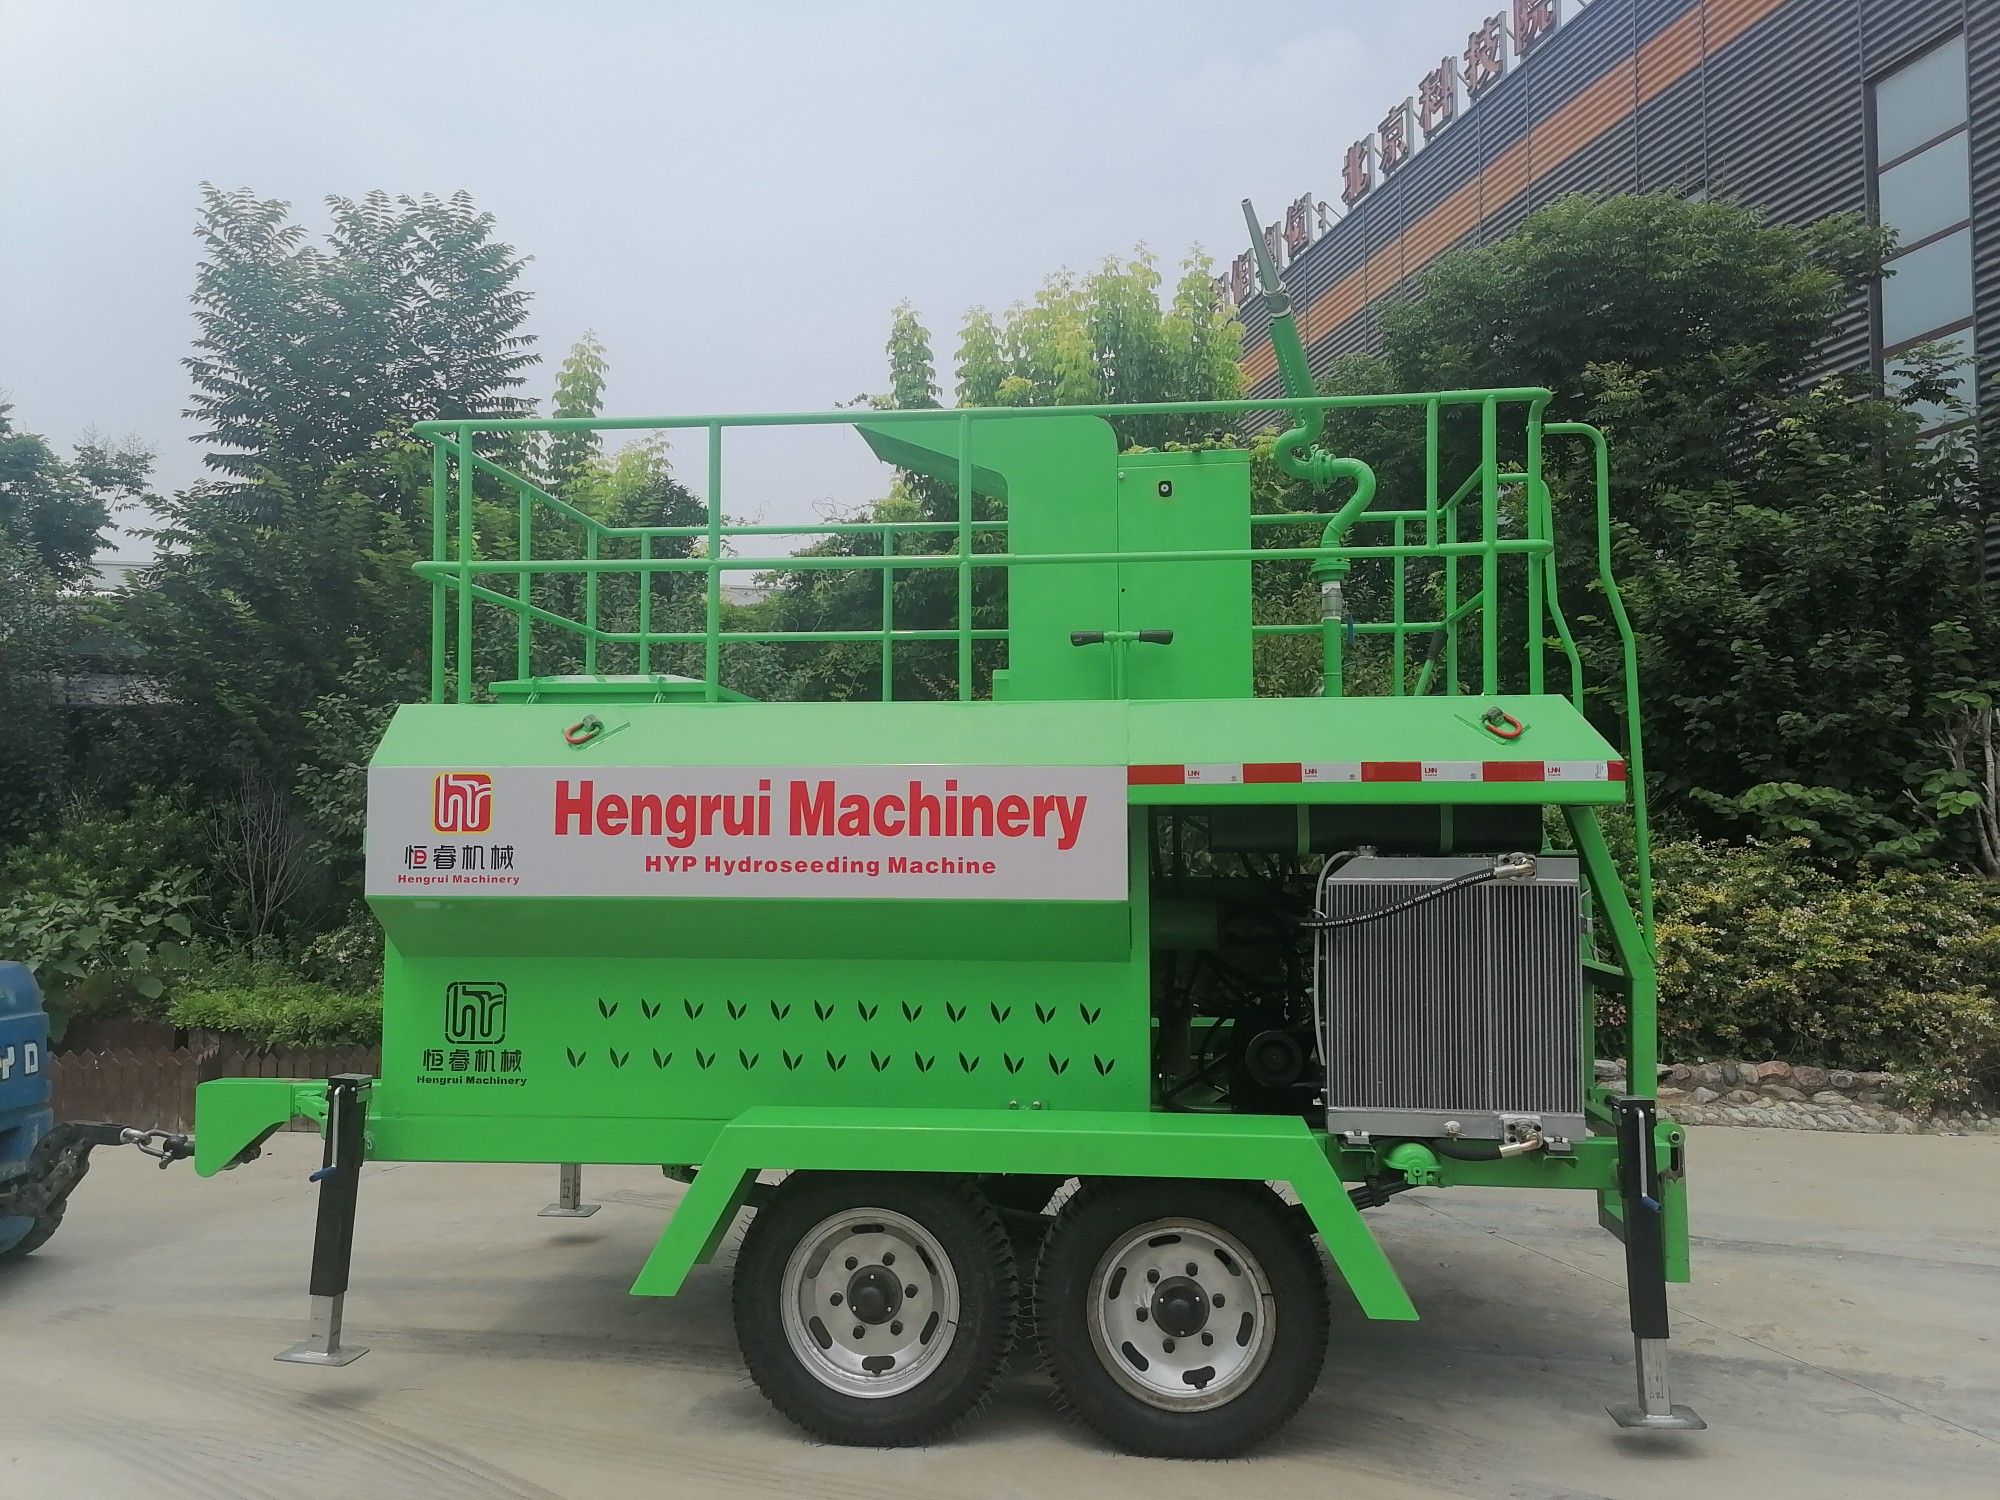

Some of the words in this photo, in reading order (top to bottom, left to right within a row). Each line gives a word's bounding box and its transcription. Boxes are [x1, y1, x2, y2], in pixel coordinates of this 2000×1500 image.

[554, 779, 771, 849] Hengrui
[789, 779, 1088, 850] Machinery
[404, 845, 515, 870] 恒睿机械
[645, 855, 697, 872] HYP
[705, 856, 880, 876] Hydroseeding
[888, 856, 996, 874] Machine
[397, 875, 449, 885] Hengrui
[452, 875, 520, 885] Machinery
[1458, 872, 1491, 886] HYDRAULIC
[422, 1048, 522, 1073] 恒睿机械
[416, 1075, 463, 1086] Hengrui
[465, 1076, 527, 1086] Machinery
